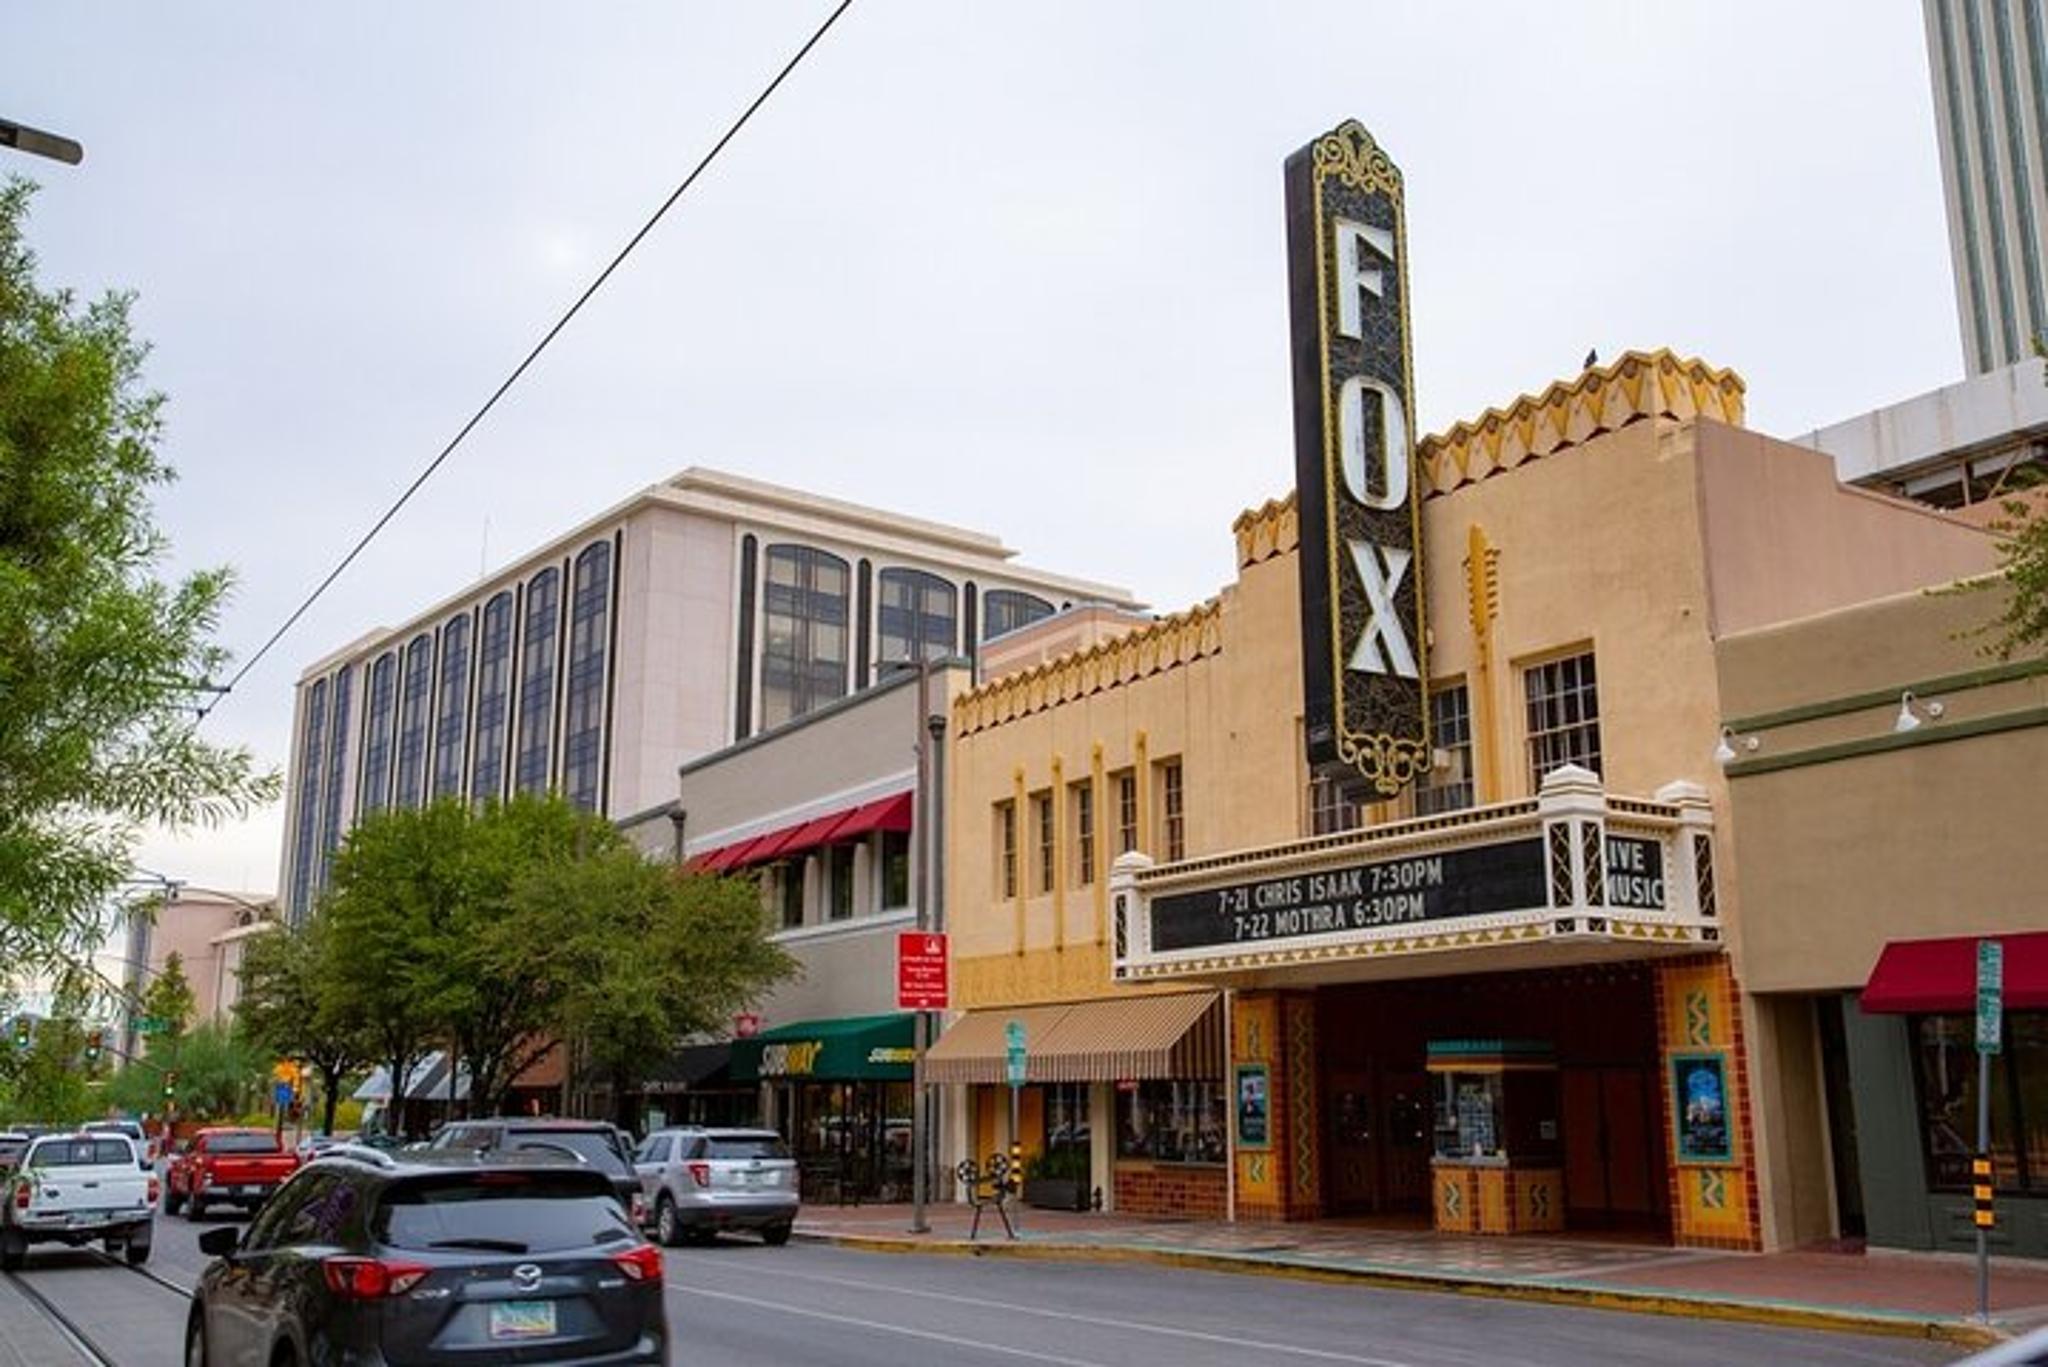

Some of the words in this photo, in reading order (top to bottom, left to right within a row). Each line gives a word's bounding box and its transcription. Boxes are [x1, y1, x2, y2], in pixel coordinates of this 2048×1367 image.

[1335, 219, 1419, 678] FOX
[1606, 841, 1645, 870] IVE
[1255, 880, 1301, 908] CHRIS
[1309, 869, 1362, 901] ISAAK
[1370, 857, 1443, 892] 7:30PM
[1234, 914, 1268, 940] 7-22
[1275, 904, 1346, 934] MOTHRA
[1353, 892, 1425, 926] 6:30PM
[758, 1040, 823, 1075] SUBWAY
